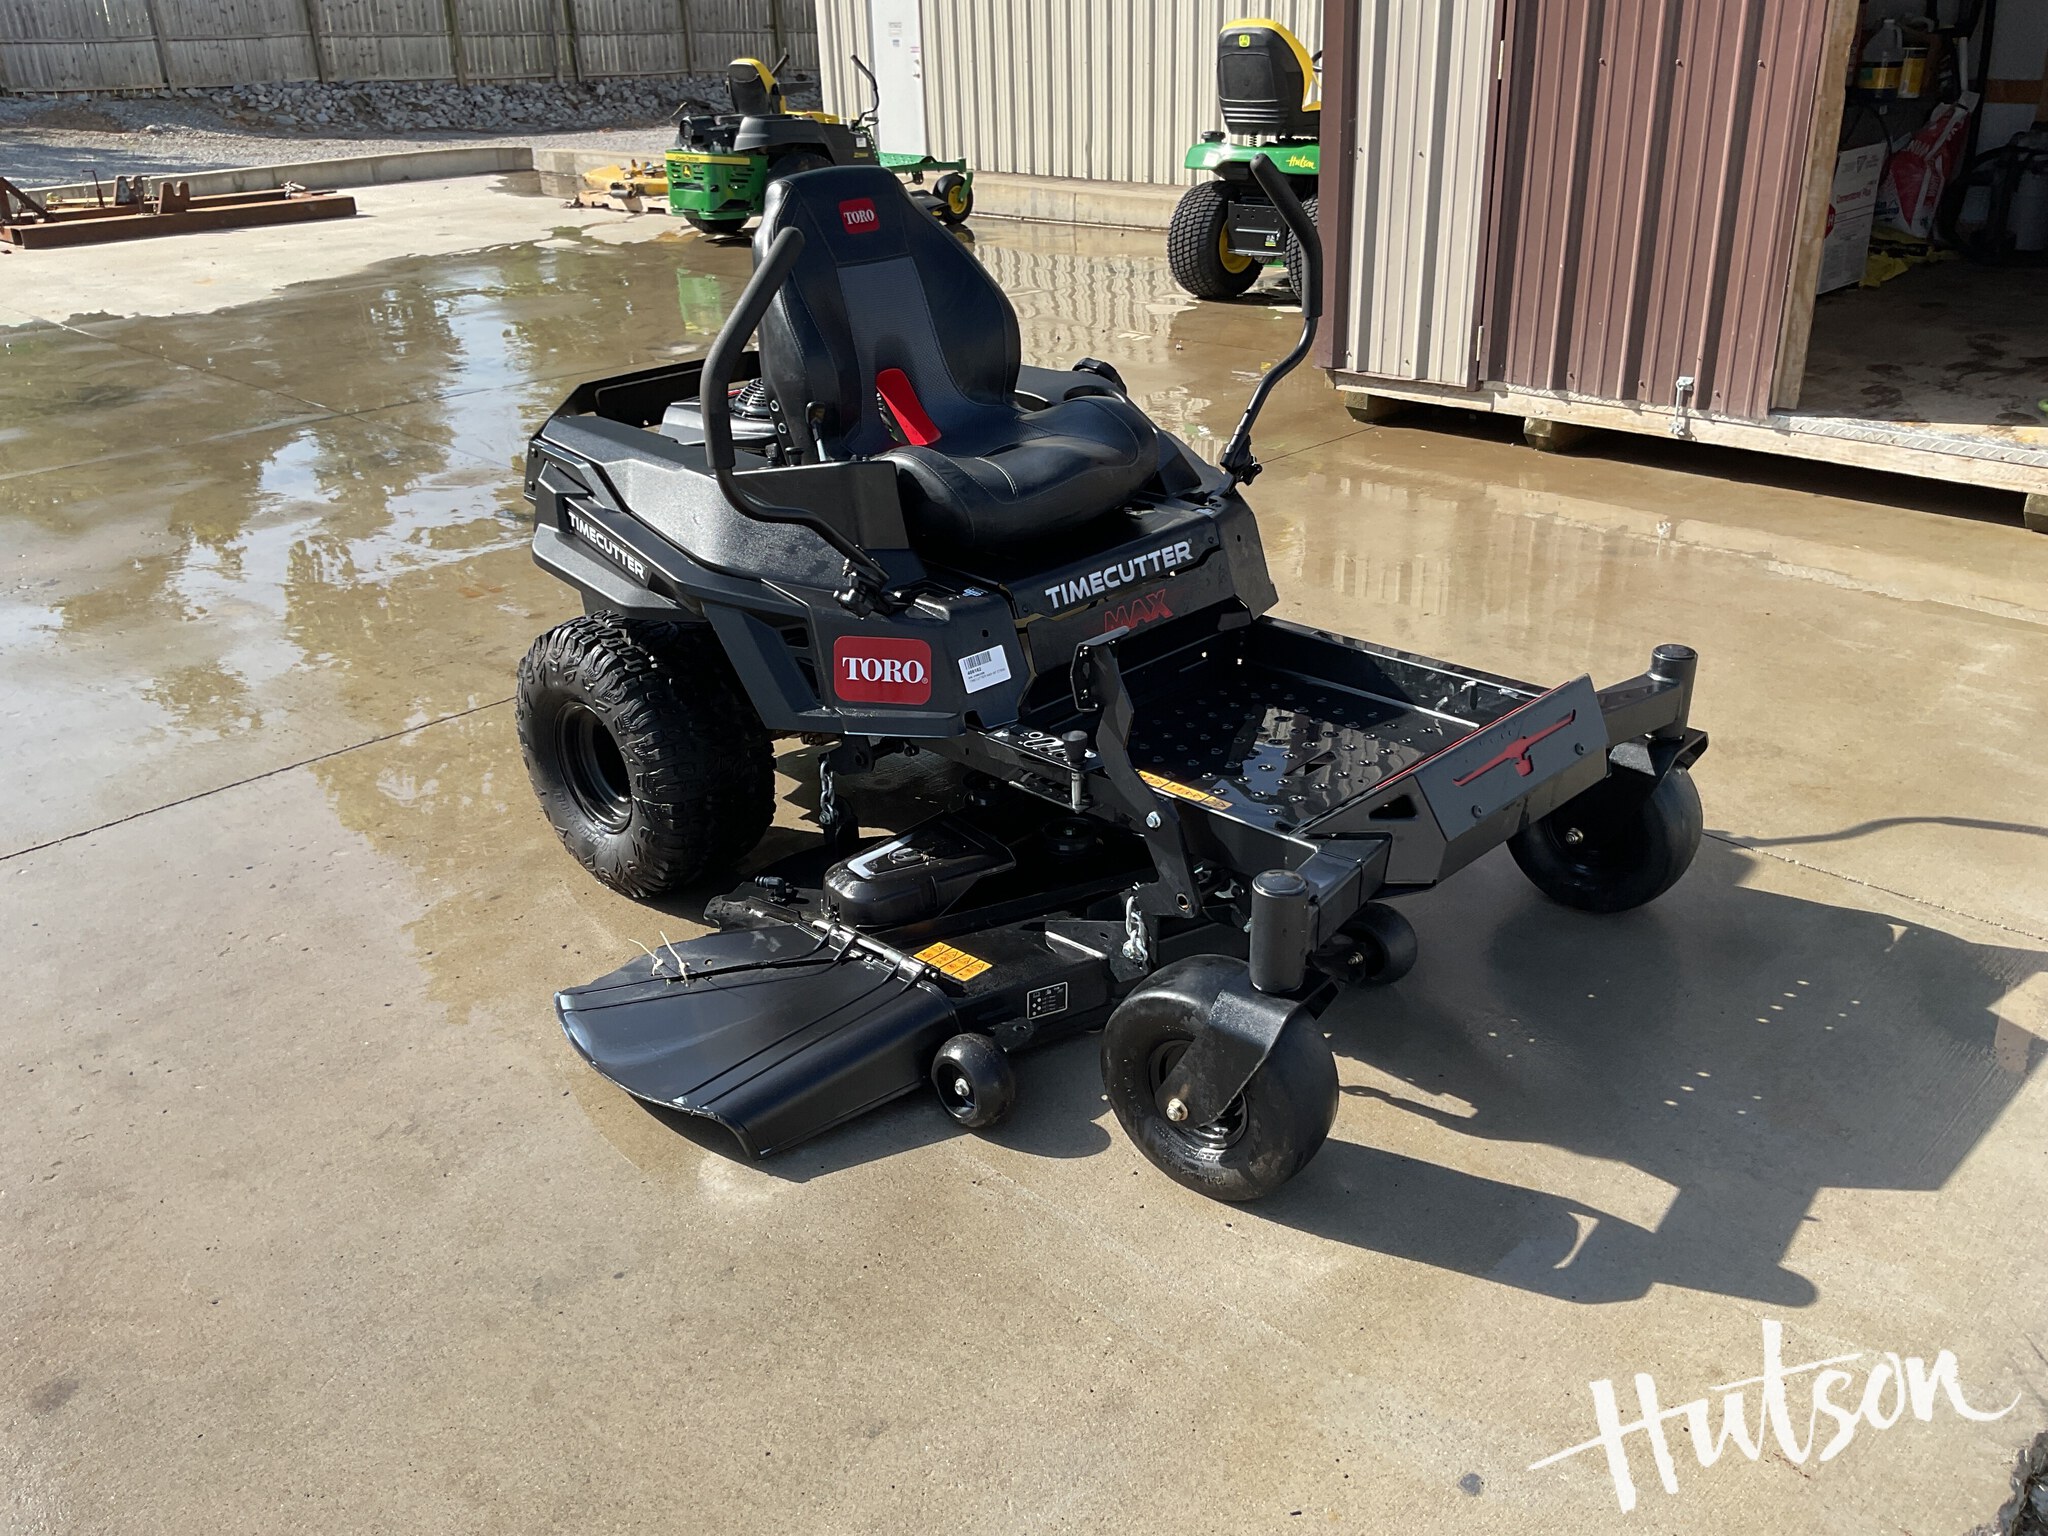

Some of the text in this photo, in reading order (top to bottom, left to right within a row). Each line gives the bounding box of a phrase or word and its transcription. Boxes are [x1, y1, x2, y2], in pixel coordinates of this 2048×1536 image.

[1286, 155, 1316, 169] Hutson
[843, 209, 875, 225] TORO
[568, 511, 645, 580] TIMECUTTER
[1044, 541, 1194, 609] TIMECUTTER
[1104, 588, 1174, 633] MAX
[842, 656, 925, 684] TORO
